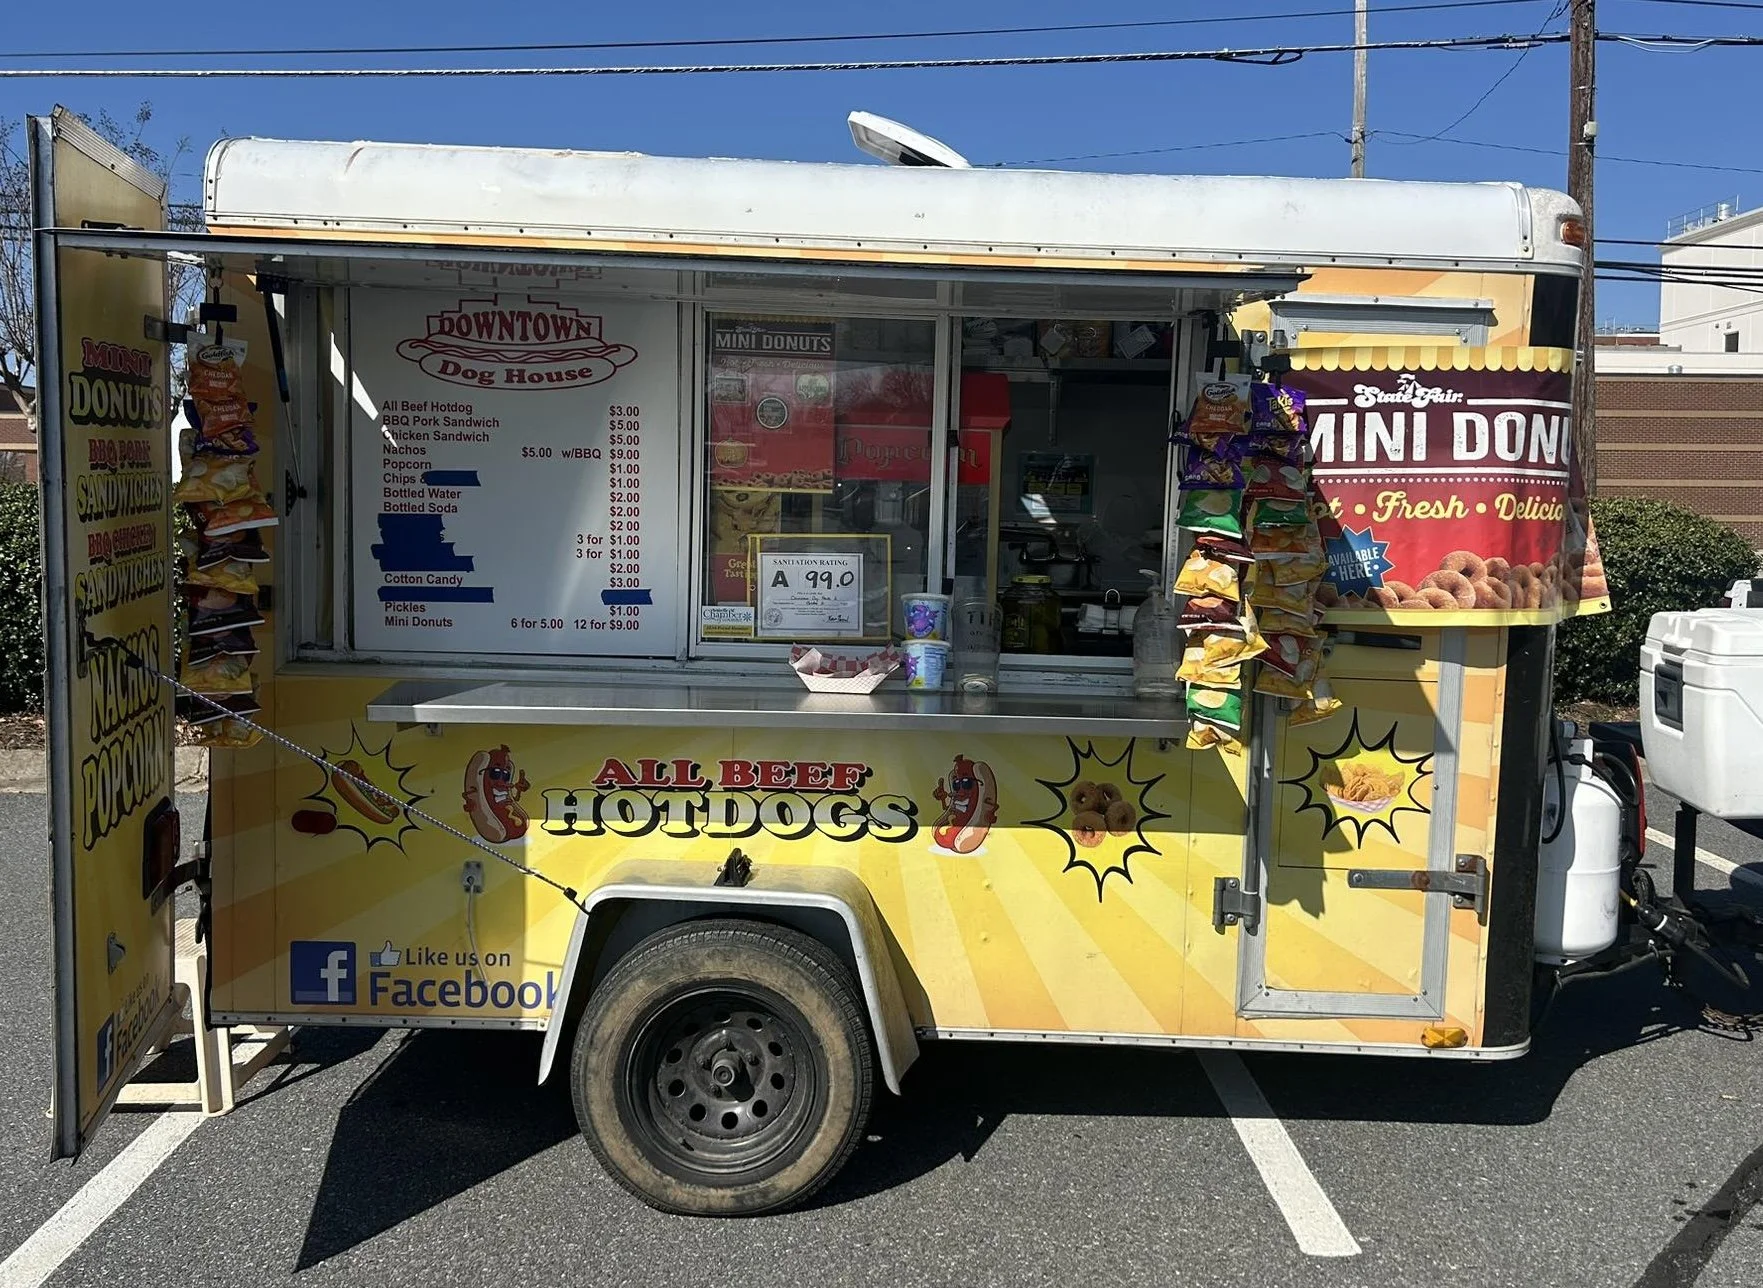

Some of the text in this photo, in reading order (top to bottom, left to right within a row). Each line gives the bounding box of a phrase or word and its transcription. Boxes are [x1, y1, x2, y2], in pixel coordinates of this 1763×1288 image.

[437, 310, 592, 342] DOWNTOWN
[715, 332, 832, 352] MINI DONUTS
[82, 338, 152, 379] MINI
[438, 360, 593, 385] Dog House
[69, 372, 163, 429] DONUTS
[1353, 384, 1412, 408] State
[382, 401, 639, 417] All Beef Hotdog $3.00
[383, 415, 639, 432] BBQ Pork Sandwich $5.00
[433, 431, 490, 442] Sandwich
[609, 434, 639, 446] $5.00
[88, 439, 117, 472] BBQ
[383, 444, 639, 460] Nachos $5.00 w/BBQ $9.00
[383, 459, 639, 474] Popcorn $1.00
[383, 473, 416, 485] Chips
[609, 477, 639, 489] $1.00
[77, 472, 162, 522] SANDWICHES
[383, 488, 639, 503] Bottled Water $2.00
[384, 502, 639, 517] Bottled Soda $2.00
[1372, 491, 1470, 522] Fresh
[88, 532, 112, 565] BBQ
[577, 534, 639, 546] 3 for $1.00
[576, 548, 639, 560] 3 for $1.00
[819, 559, 848, 567] RATING
[1328, 546, 1380, 566] AVAILABLE
[609, 563, 639, 574] $2.00
[1338, 561, 1373, 581] HERE
[75, 551, 165, 616] SANDWICHES
[384, 573, 639, 588] Cotton Candy $3.00
[771, 570, 854, 590] A 99.0
[385, 602, 639, 617] Pickles $1.00
[385, 616, 639, 631] Mini Donuts 6 for 5.00 12 for $9.00
[88, 625, 160, 744] NACHOS
[82, 705, 167, 850] POPCORN
[591, 758, 873, 792] ALL BEEF
[541, 788, 919, 843] HOTDOGS
[406, 948, 511, 966] Like us on
